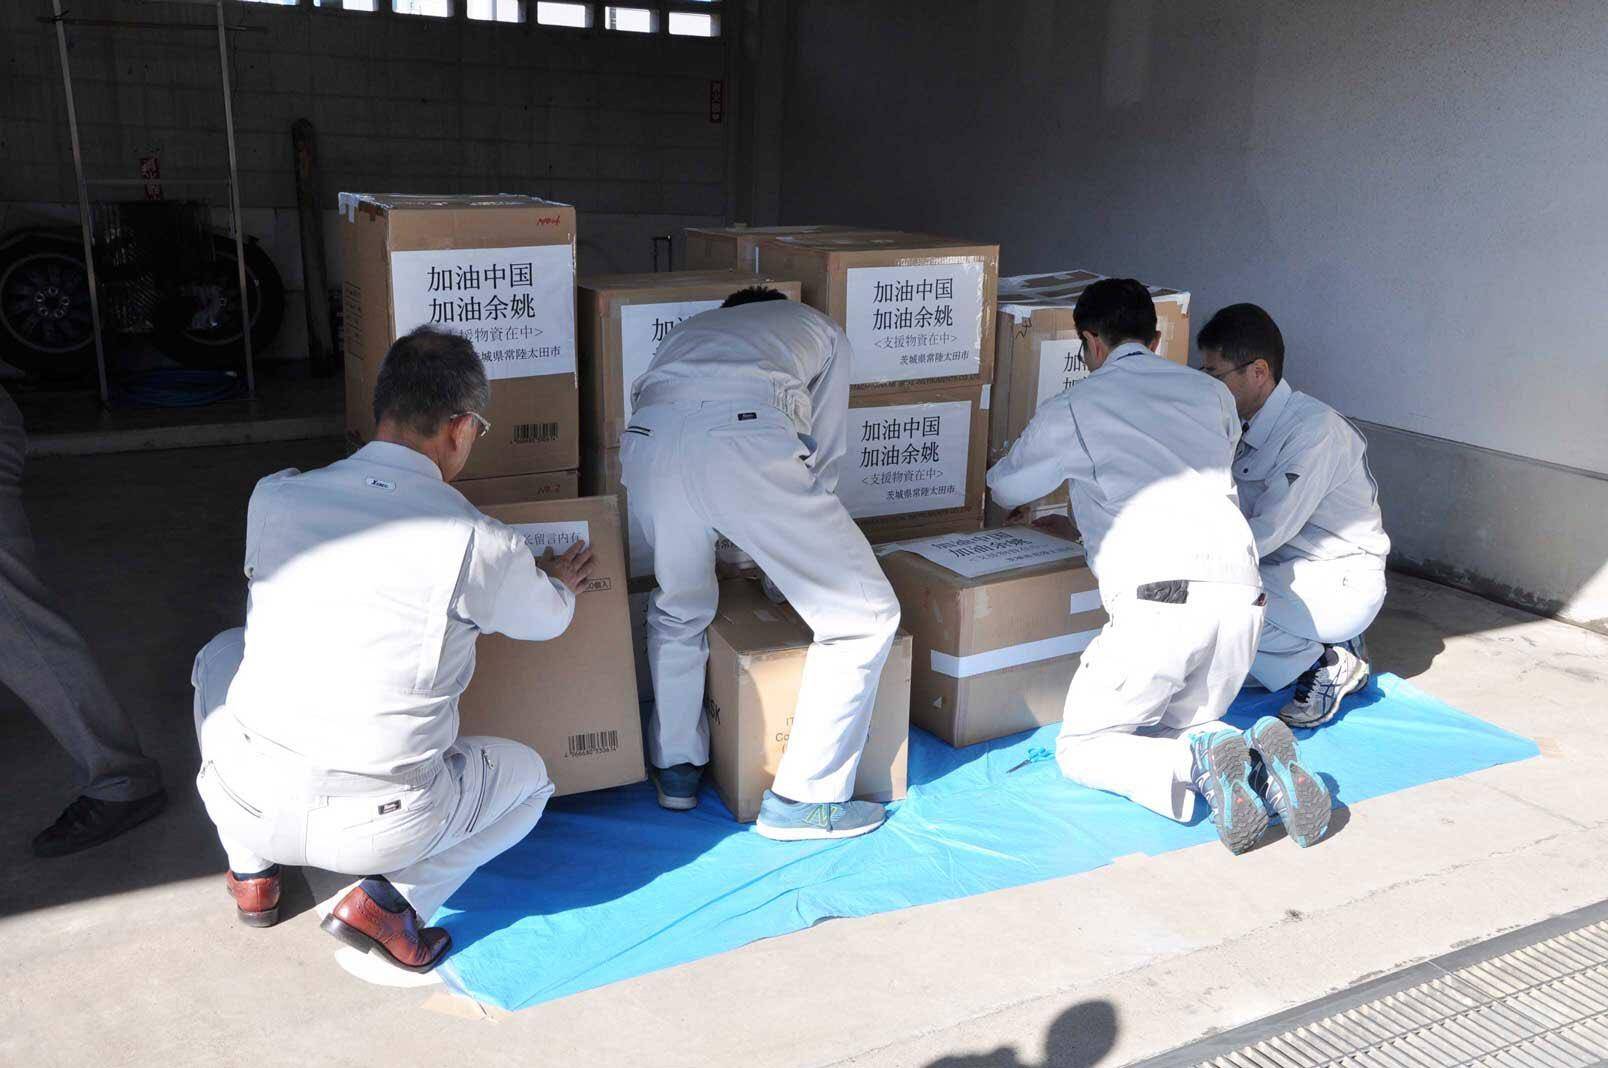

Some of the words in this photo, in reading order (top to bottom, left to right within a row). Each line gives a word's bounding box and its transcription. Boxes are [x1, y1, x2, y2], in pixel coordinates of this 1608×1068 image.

[427, 262, 534, 292] 加油中国
[872, 277, 953, 304] 加油中国
[428, 292, 536, 324] 加油余姚
[872, 304, 953, 331] 加油余姚
[473, 345, 561, 364] 城県常陸太田市
[899, 349, 970, 366] 茨城県常陸太田市
[860, 415, 941, 443] 加油中国
[859, 441, 940, 469] 加油余姚
[886, 484, 956, 501] 茨城県常陸太田市
